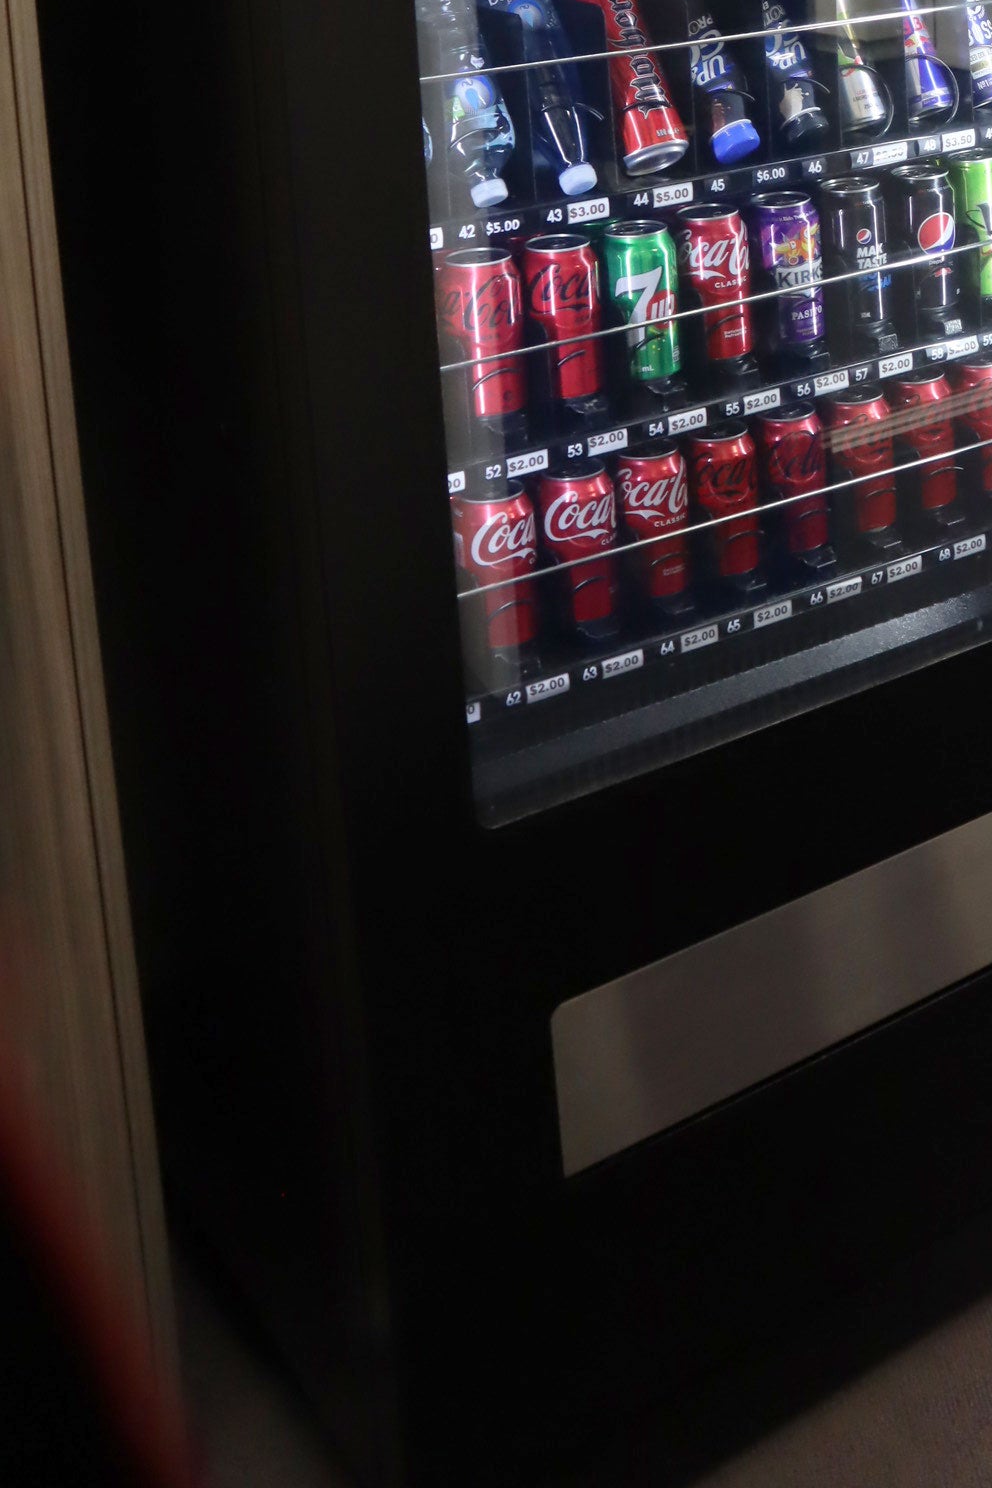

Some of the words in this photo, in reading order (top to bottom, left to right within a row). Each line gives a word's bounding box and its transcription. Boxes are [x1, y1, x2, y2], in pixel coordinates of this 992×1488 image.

[945, 134, 973, 148] $3.50
[808, 160, 823, 174] 46
[857, 152, 870, 164] 47
[710, 178, 726, 193] 45
[756, 167, 786, 183] $6.00
[633, 192, 649, 207] 44
[655, 188, 690, 203] $5.00
[547, 208, 563, 223] 43
[569, 203, 606, 219] $3.00
[459, 224, 476, 240] 42
[485, 218, 521, 236] $5.00
[714, 276, 747, 288] CLASC
[931, 348, 944, 360] 58
[855, 368, 869, 381] 57
[881, 358, 910, 373] $2.00
[797, 384, 811, 397] 56
[816, 372, 846, 388] $2.00
[725, 403, 740, 416] 55
[746, 393, 778, 410] $2.00
[649, 422, 665, 436] 54
[671, 413, 704, 430] $2.00
[567, 444, 583, 458] 53
[589, 431, 625, 448] $2.00
[485, 465, 502, 479] 52
[509, 455, 545, 472] $2.00
[544, 490, 616, 542] Coca
[938, 547, 951, 562] 68
[955, 538, 983, 555] $2.00
[871, 570, 884, 585] 67
[889, 560, 918, 579] $2.00
[810, 592, 824, 606] 66
[828, 582, 860, 600] $2.00
[726, 618, 741, 633] 65
[756, 605, 788, 623] $2.00
[660, 640, 675, 656] 64
[684, 629, 716, 647] $2.00
[582, 665, 598, 682] 63
[604, 654, 640, 674] $2.00
[506, 691, 522, 707] 62
[529, 677, 566, 696] $2.00
